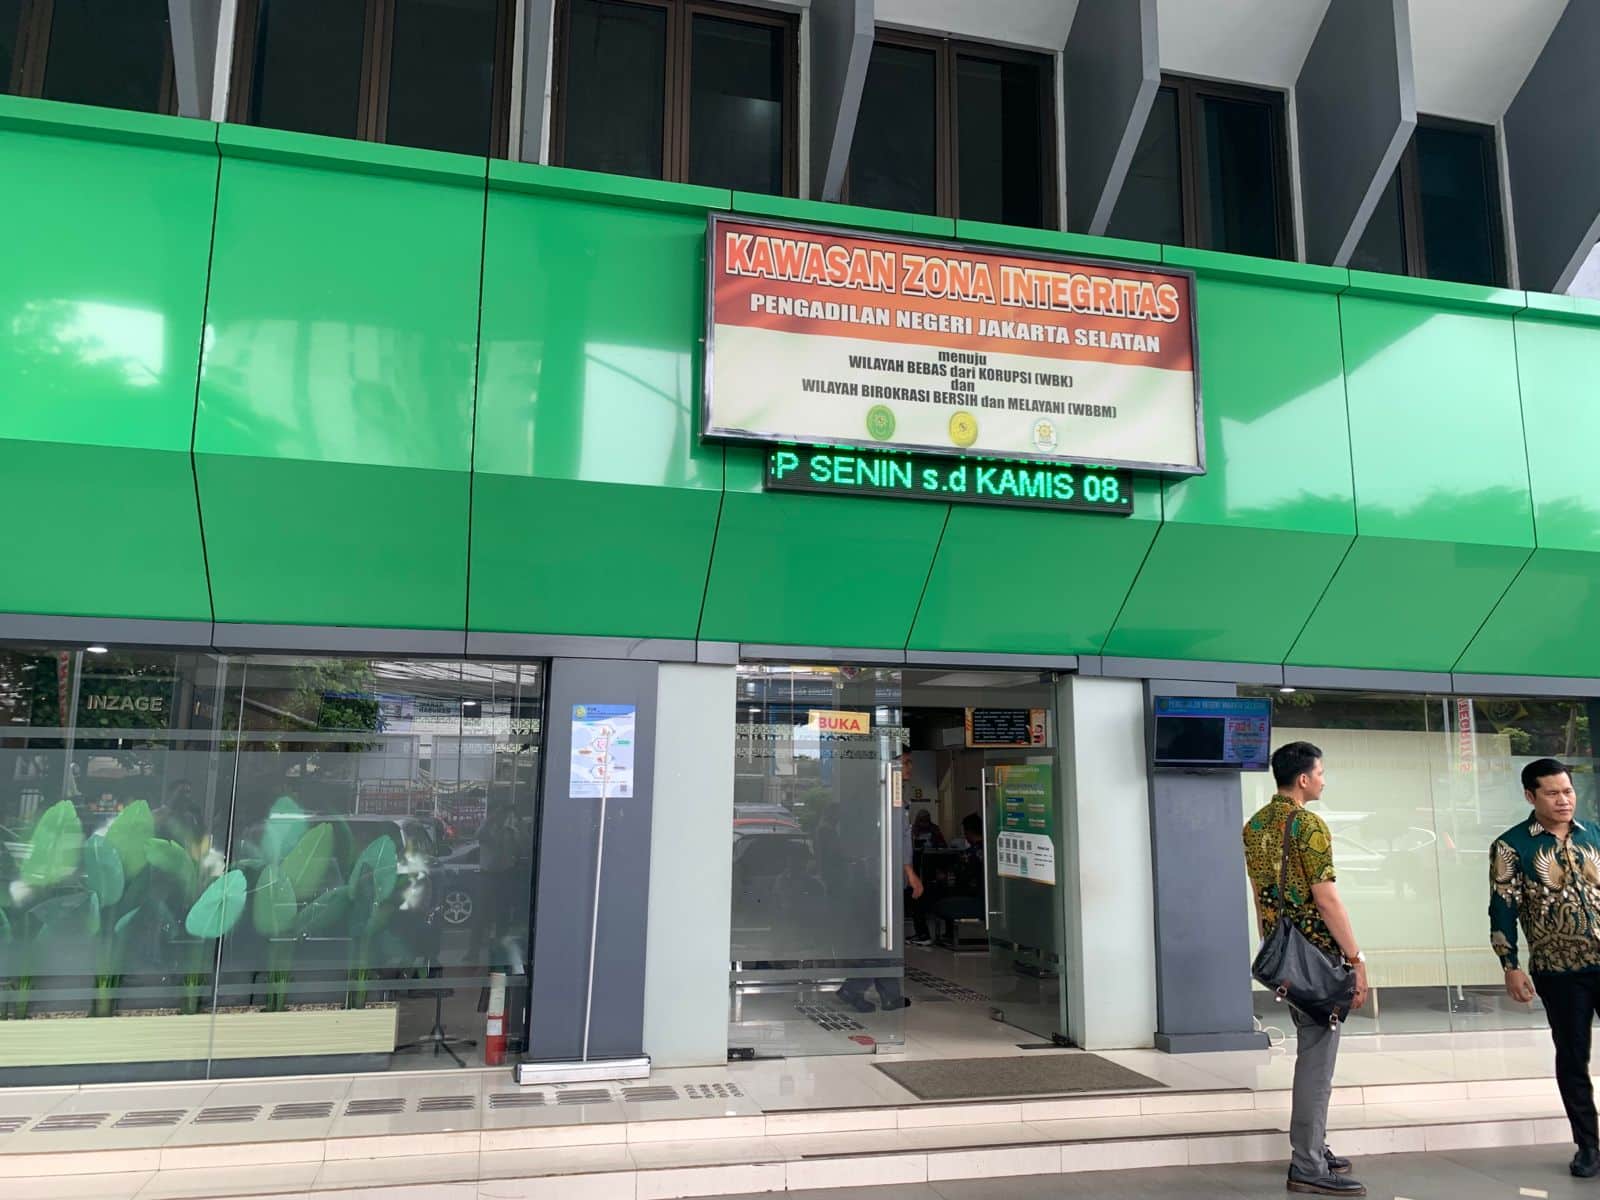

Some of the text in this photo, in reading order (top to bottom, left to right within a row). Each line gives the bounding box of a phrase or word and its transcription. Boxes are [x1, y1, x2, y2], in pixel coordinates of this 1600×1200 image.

[725, 231, 1180, 323] KAWASAN ZONA INTEGRITAS
[750, 293, 1160, 353] PENGADILAN NEGERI JAKARTA SELATAN
[849, 355, 1073, 388] WILAYAH BEBAS dari KORUPSI (WBK)
[938, 351, 987, 366] menuju
[802, 378, 1117, 419] WILAYAH BIROKRASI BERSIH dan MELAYANI (WBBM)
[951, 378, 975, 392] dan
[810, 455, 912, 489] SENIN
[922, 465, 967, 493] s.d
[976, 467, 1074, 500] KAMIS
[1083, 475, 1128, 504] 08.
[87, 694, 163, 712] INZAGE
[818, 716, 861, 731] BUKA
